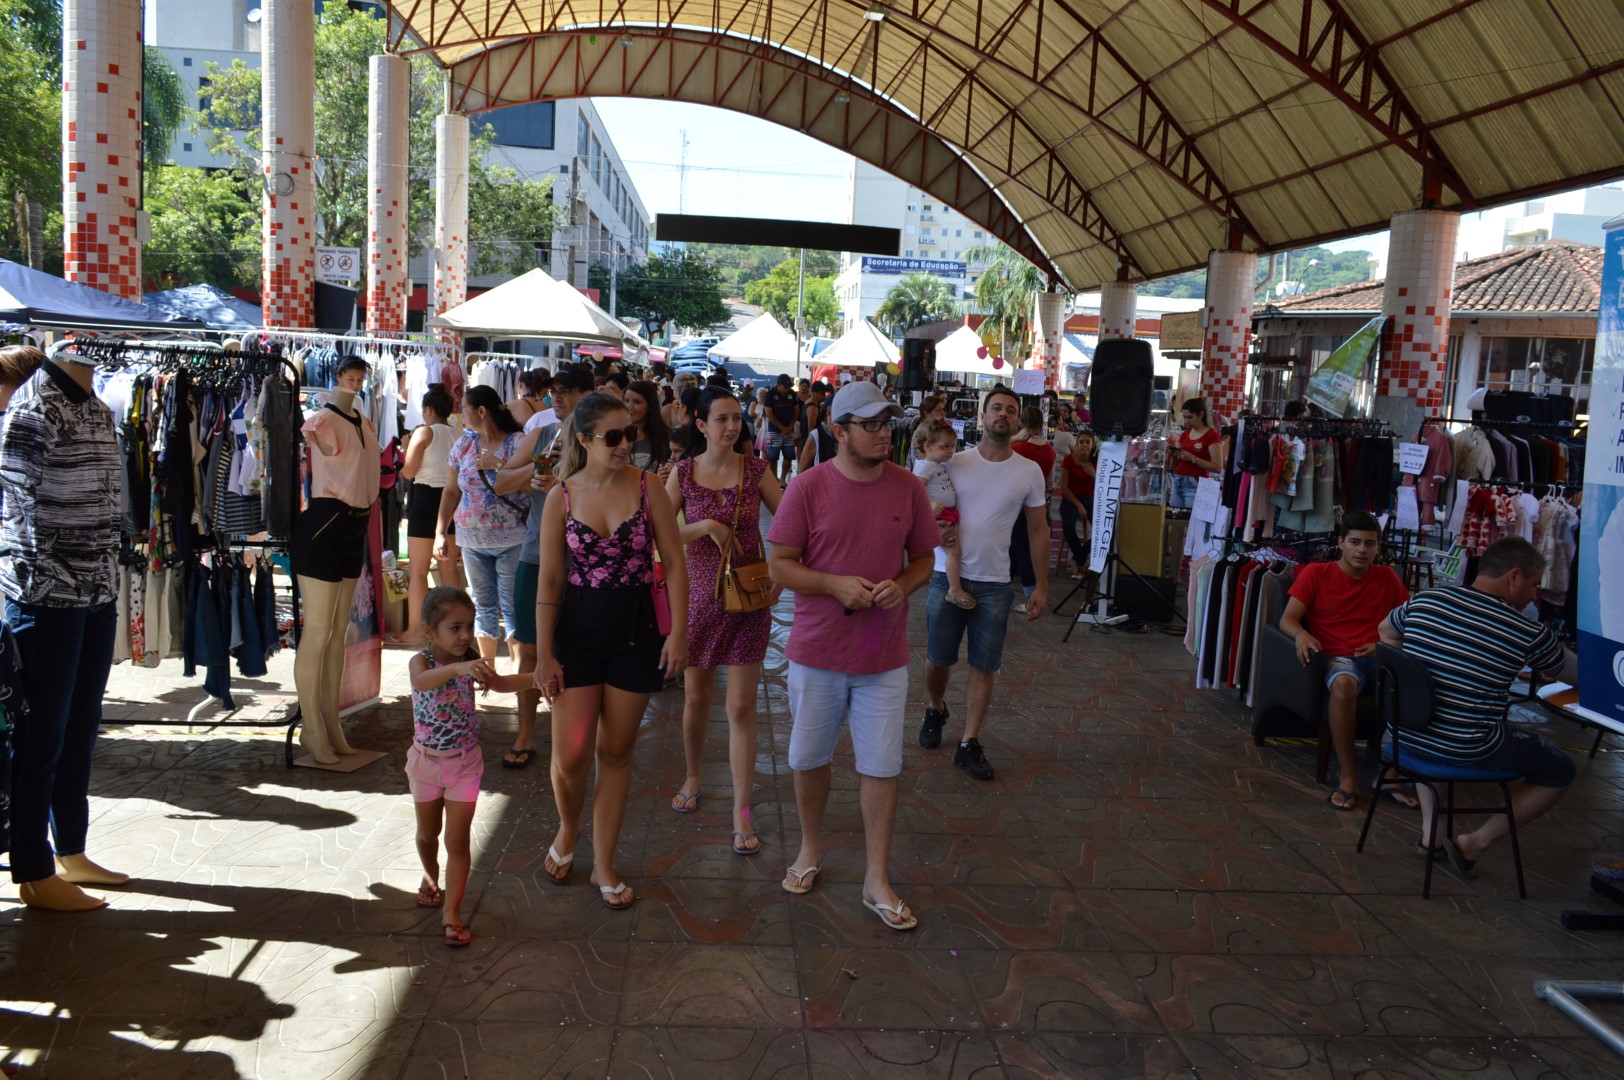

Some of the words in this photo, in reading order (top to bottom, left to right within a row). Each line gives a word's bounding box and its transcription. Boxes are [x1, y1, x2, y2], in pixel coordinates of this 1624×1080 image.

[866, 257, 908, 268] Secretaria
[921, 261, 959, 270] Educação
[1099, 458, 1108, 483] Moda
[1099, 460, 1123, 559] ALLMEGE
